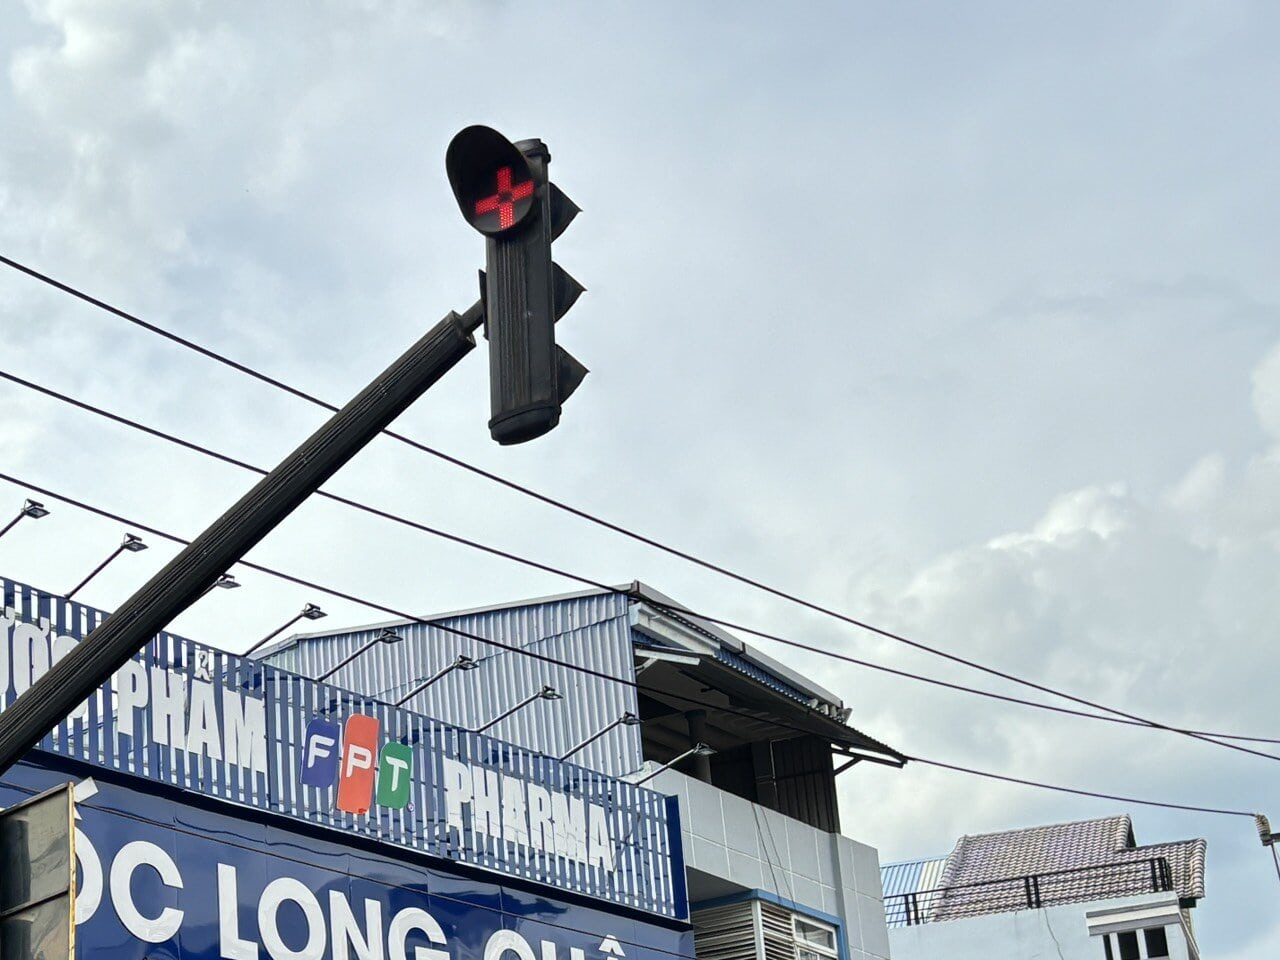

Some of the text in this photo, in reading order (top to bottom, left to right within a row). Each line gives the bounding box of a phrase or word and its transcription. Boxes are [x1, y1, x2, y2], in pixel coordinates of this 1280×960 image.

[117, 651, 266, 773] PHẨM
[307, 734, 409, 792] FPT
[443, 758, 613, 871] PHARMA
